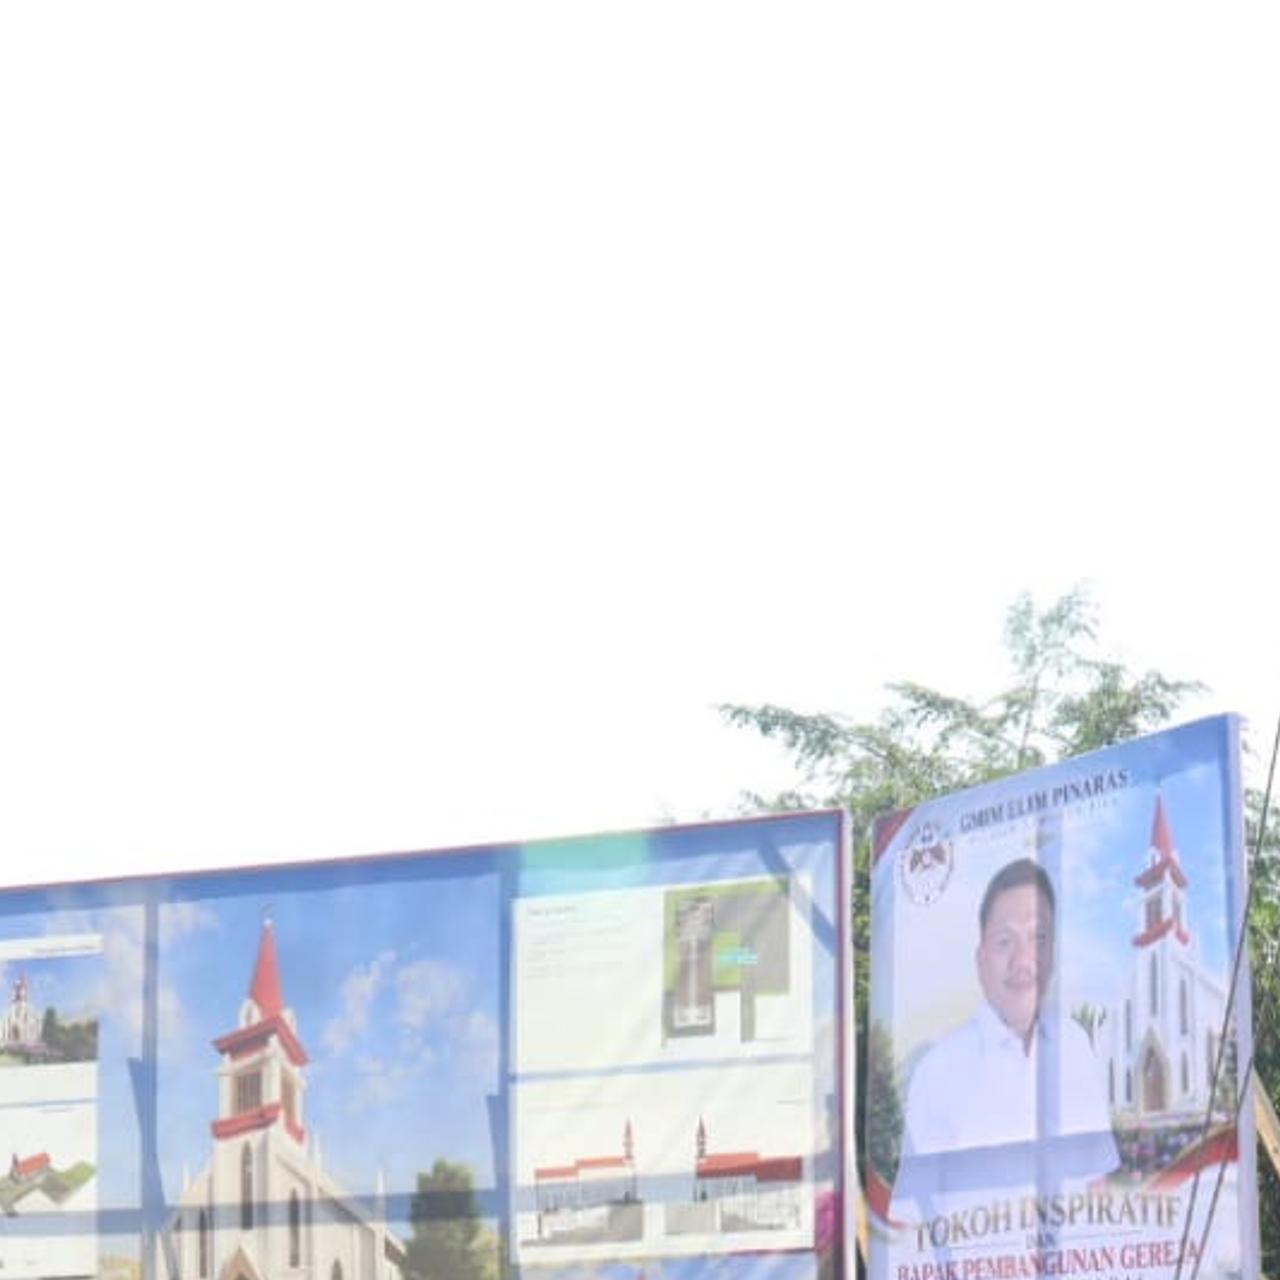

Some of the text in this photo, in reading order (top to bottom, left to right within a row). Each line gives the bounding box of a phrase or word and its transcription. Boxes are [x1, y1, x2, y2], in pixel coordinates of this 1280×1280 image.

[1052, 768, 1129, 807] PINARAS
[915, 1191, 1180, 1252] TOKOH INSPIRATIF
[1121, 1238, 1200, 1270] GEREA
